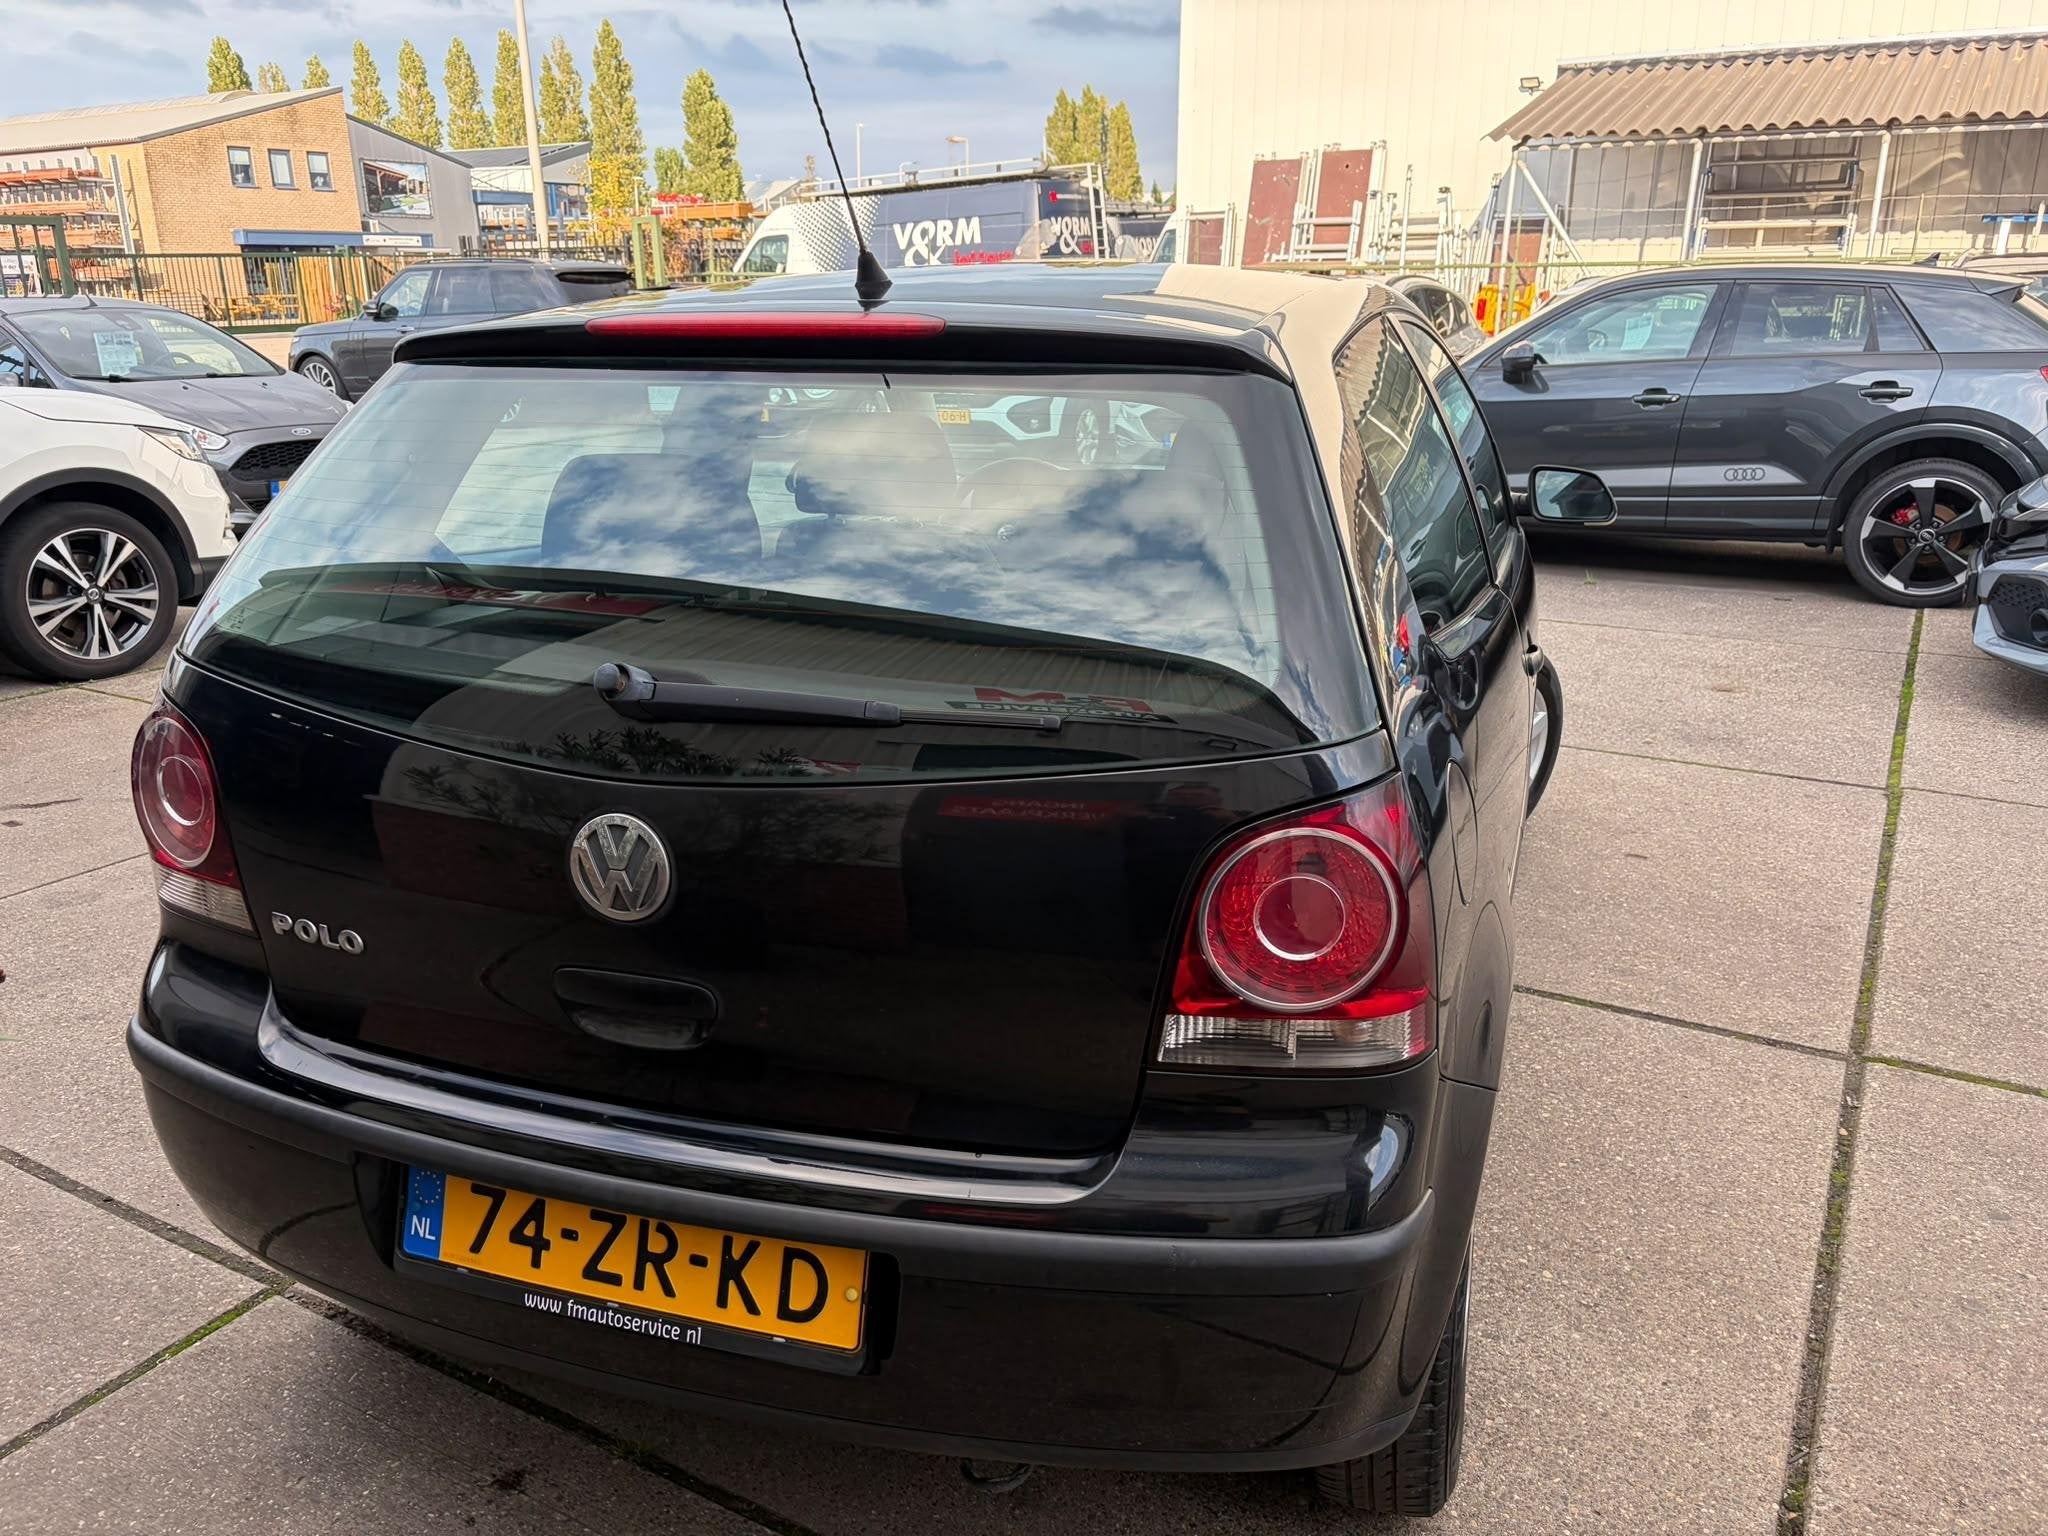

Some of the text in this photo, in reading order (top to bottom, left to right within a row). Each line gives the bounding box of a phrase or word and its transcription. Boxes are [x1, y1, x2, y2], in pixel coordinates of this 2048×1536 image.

[892, 216, 982, 249] VORM
[1051, 216, 1092, 236] VORM
[271, 911, 364, 955] POLO
[410, 1214, 437, 1242] NL
[469, 1182, 830, 1324] 74-ZR-KD
[524, 1292, 702, 1345] www fmautoservice nl
